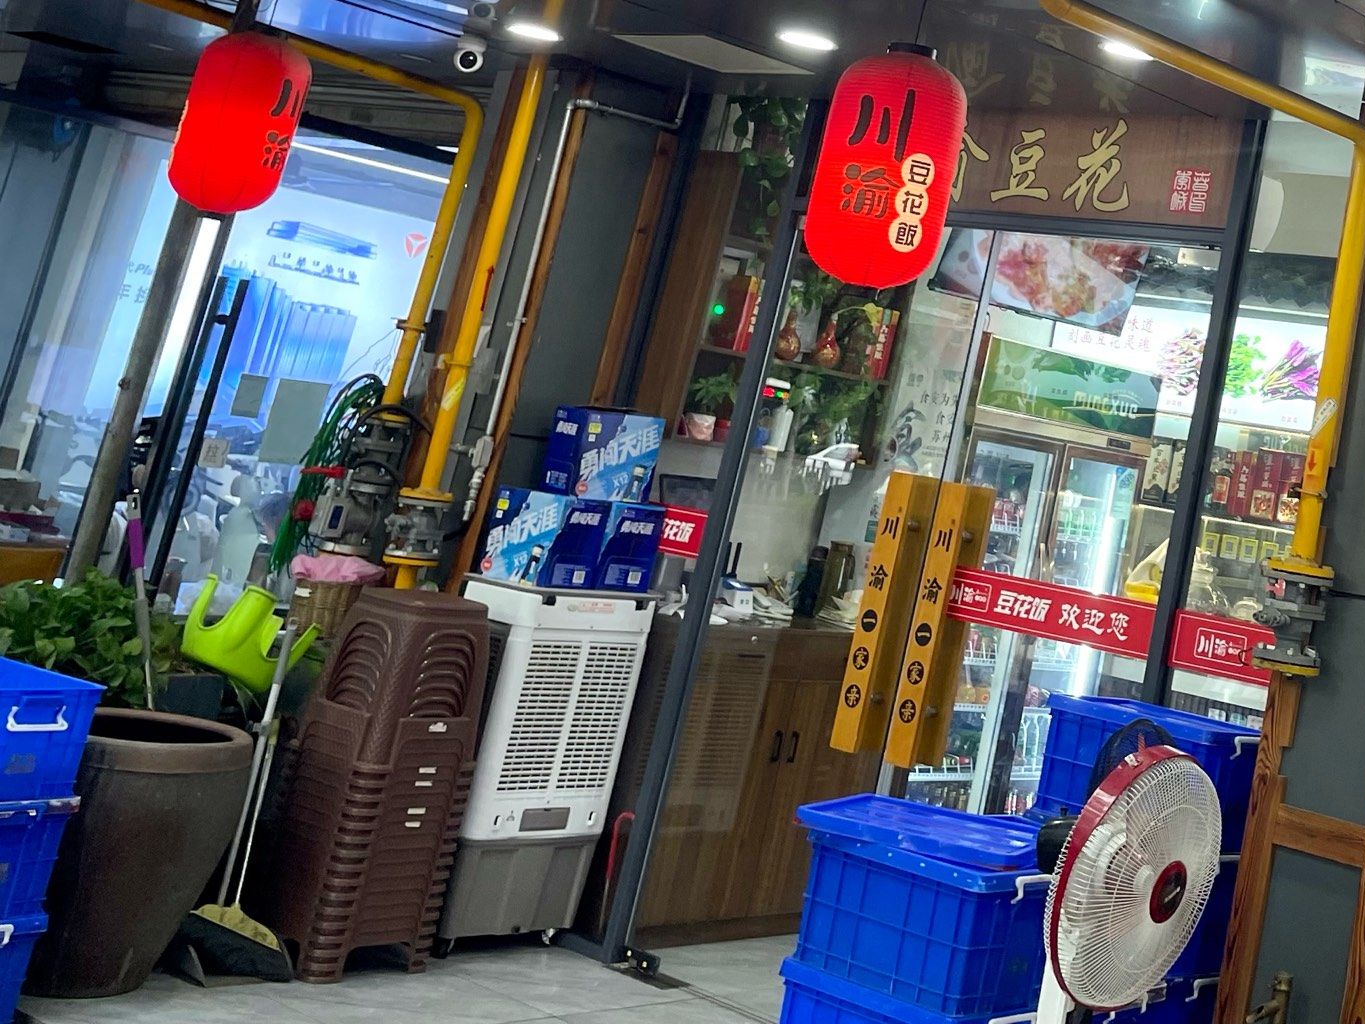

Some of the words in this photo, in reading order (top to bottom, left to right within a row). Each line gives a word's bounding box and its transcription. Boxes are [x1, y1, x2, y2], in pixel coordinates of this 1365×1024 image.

[662, 517, 695, 544] 花饭
[993, 589, 1051, 623] 豆花饭
[1058, 603, 1130, 641] 欢迎您
